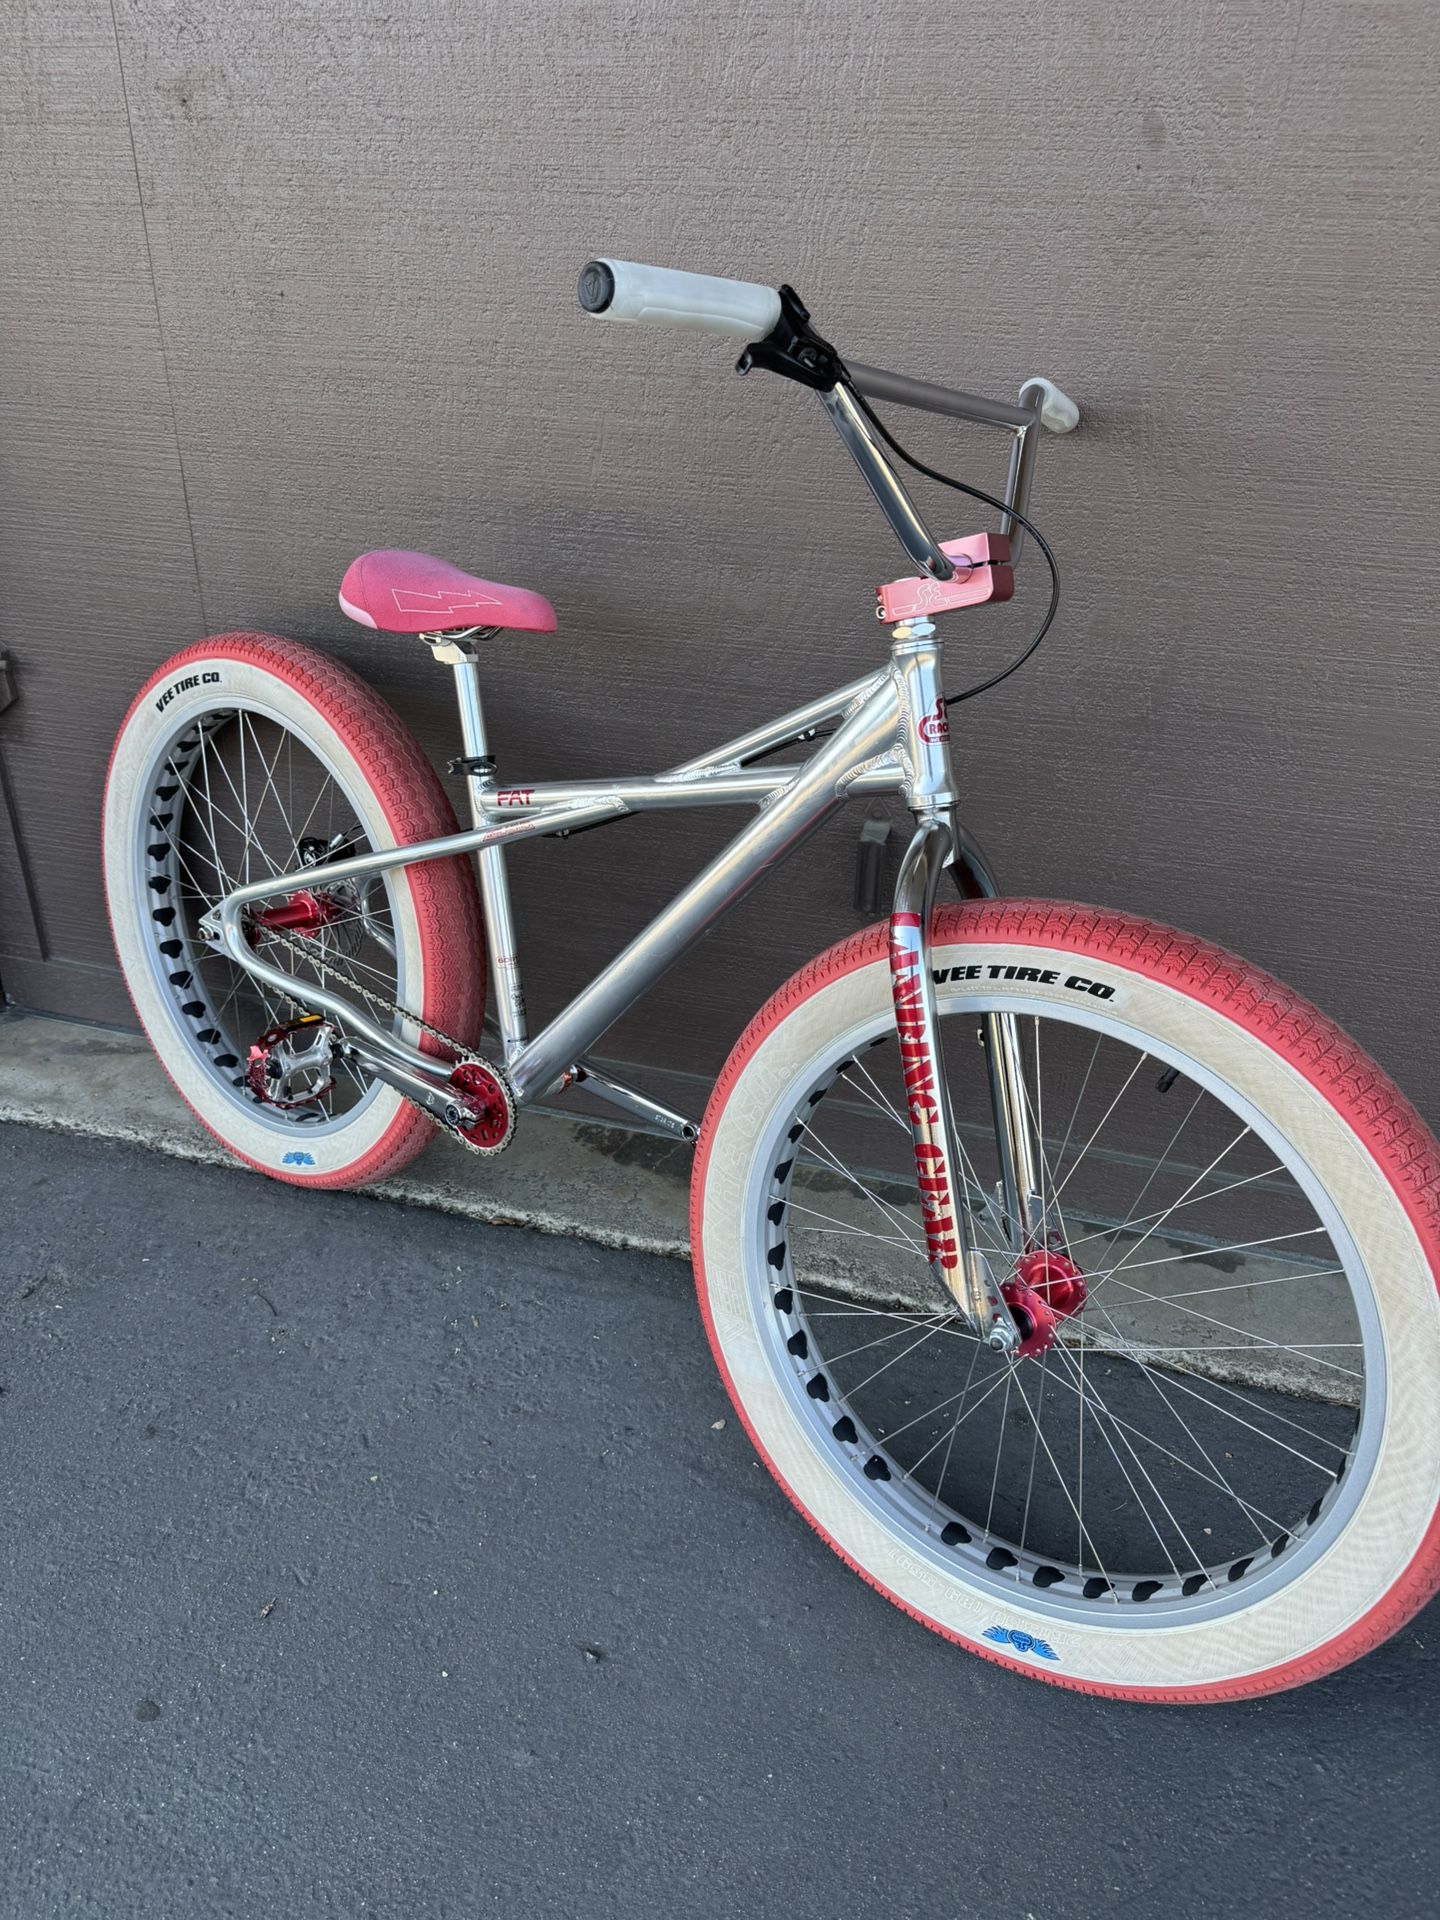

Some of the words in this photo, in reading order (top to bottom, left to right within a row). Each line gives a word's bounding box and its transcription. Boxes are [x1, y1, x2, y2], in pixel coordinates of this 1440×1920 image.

[155, 687, 175, 713] VEE
[173, 674, 200, 695] TIRE
[497, 789, 536, 807] FAT
[931, 964, 983, 985] VEE
[987, 965, 1061, 985] TIRE
[889, 912, 940, 1125] LANDING
[914, 1143, 958, 1270] GEAR
